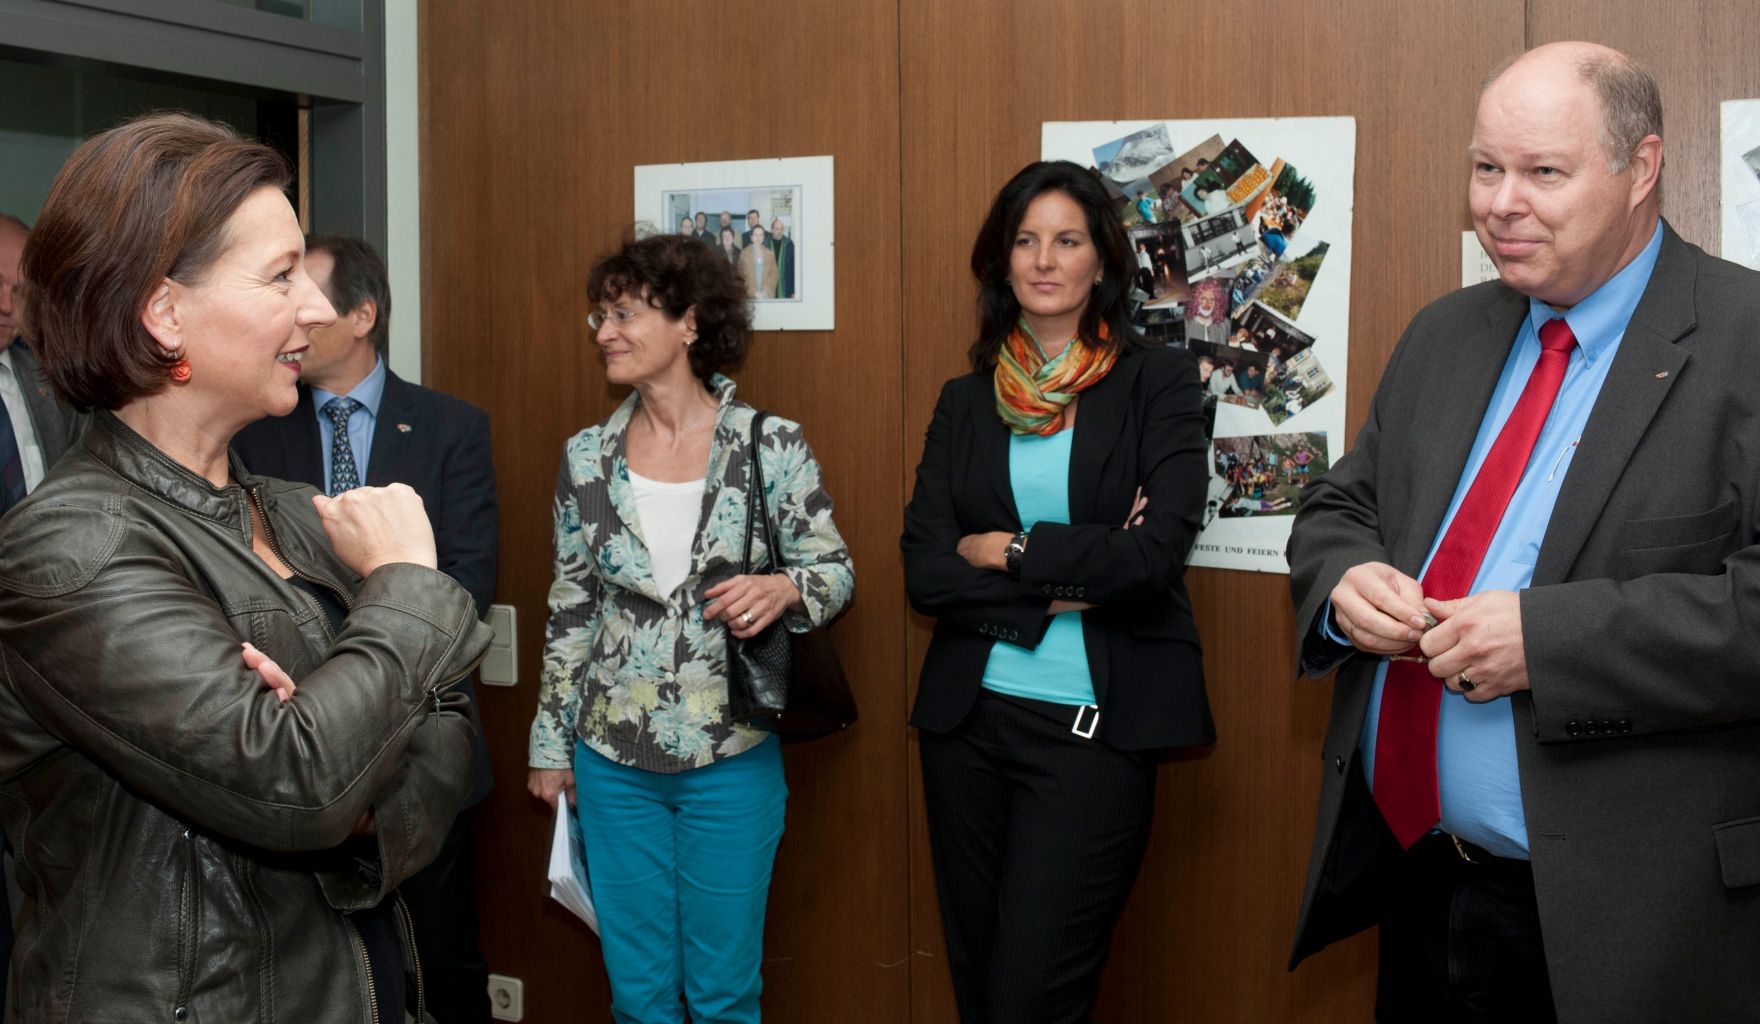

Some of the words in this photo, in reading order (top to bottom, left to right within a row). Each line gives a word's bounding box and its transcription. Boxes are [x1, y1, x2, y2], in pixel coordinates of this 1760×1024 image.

[1195, 543, 1221, 552] FESTE
[1225, 546, 1243, 554] UND
[1247, 547, 1279, 556] FEIERN
